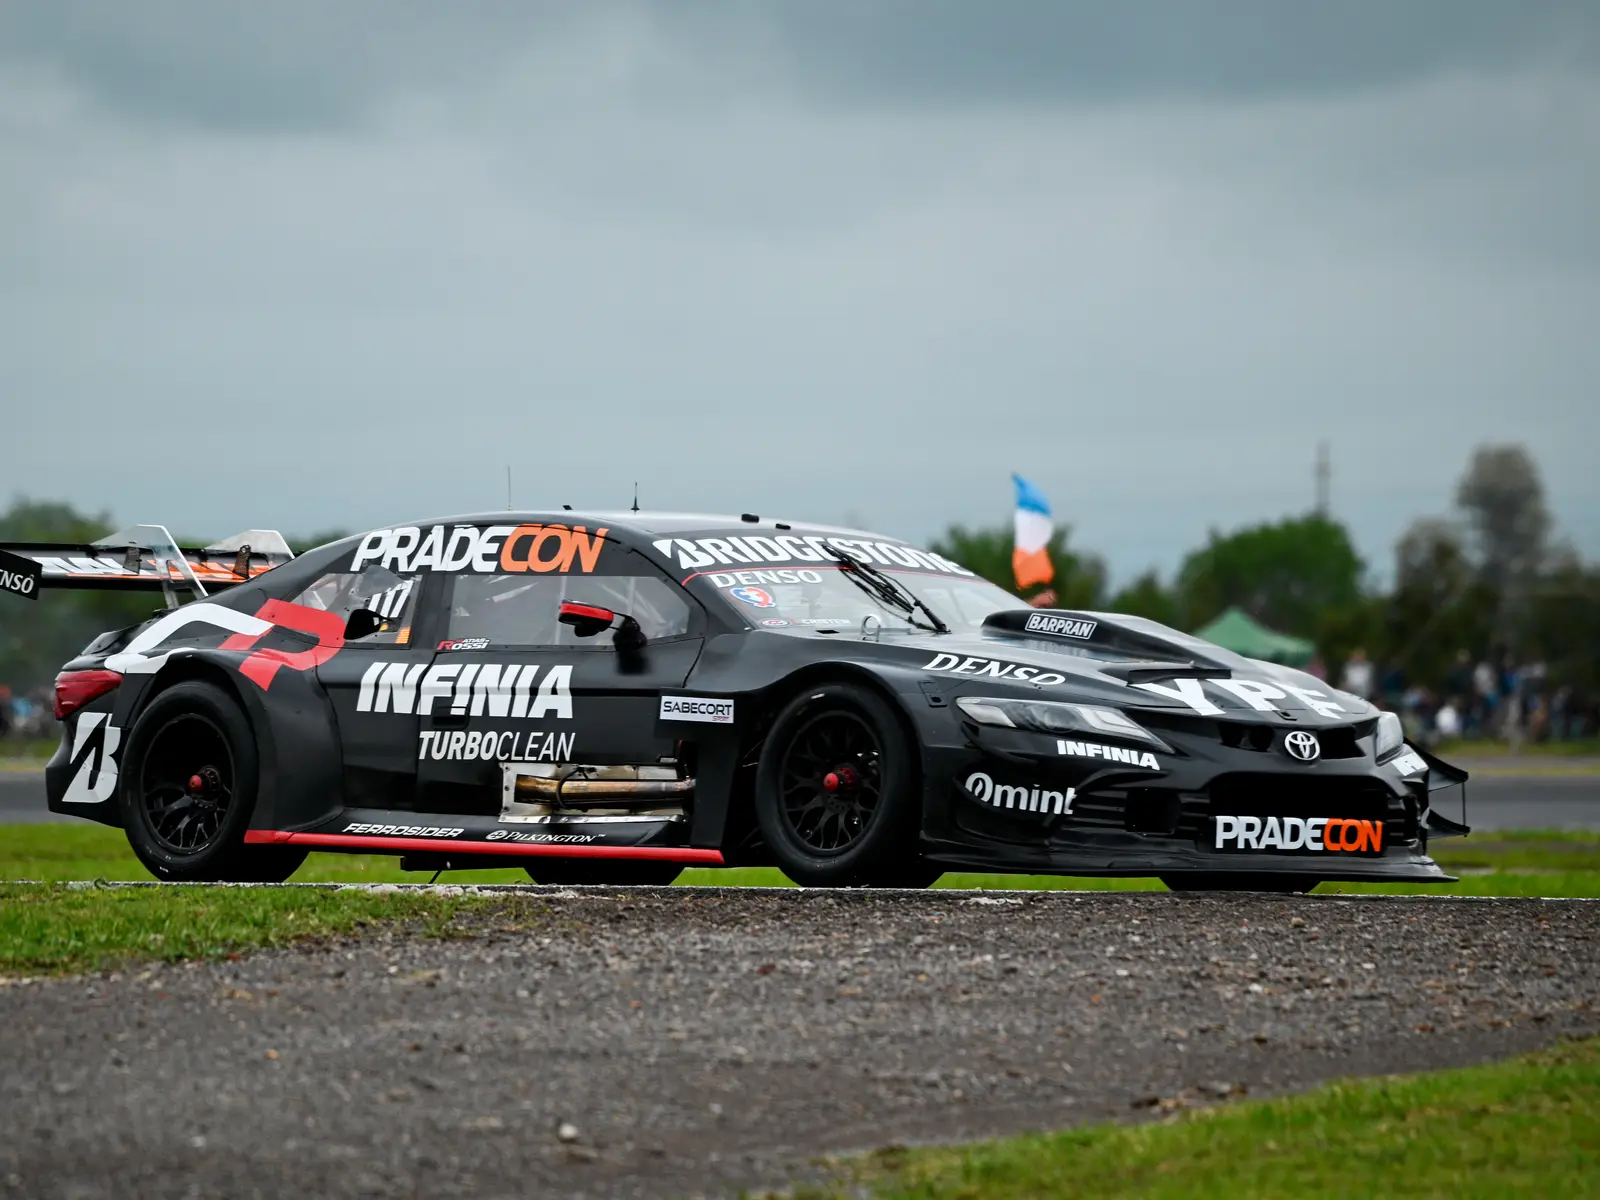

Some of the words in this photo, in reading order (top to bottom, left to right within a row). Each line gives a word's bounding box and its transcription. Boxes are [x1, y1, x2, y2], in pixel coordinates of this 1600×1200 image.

[350, 523, 609, 573] PRADECON
[652, 536, 976, 577] BRIDGESTONE
[708, 570, 823, 588] DENSO
[1029, 616, 1092, 637] BARPRAN
[436, 640, 489, 650] ROSSI
[921, 653, 1066, 685] DENSO
[356, 662, 574, 719] INFINIA
[1128, 678, 1346, 720] YPF
[663, 701, 733, 716] SABECORT
[418, 731, 576, 762] TURBOCLEAN
[1056, 740, 1161, 770] INFINIA
[342, 823, 465, 838] FERROSIDER
[1215, 815, 1383, 852] PRADECON
